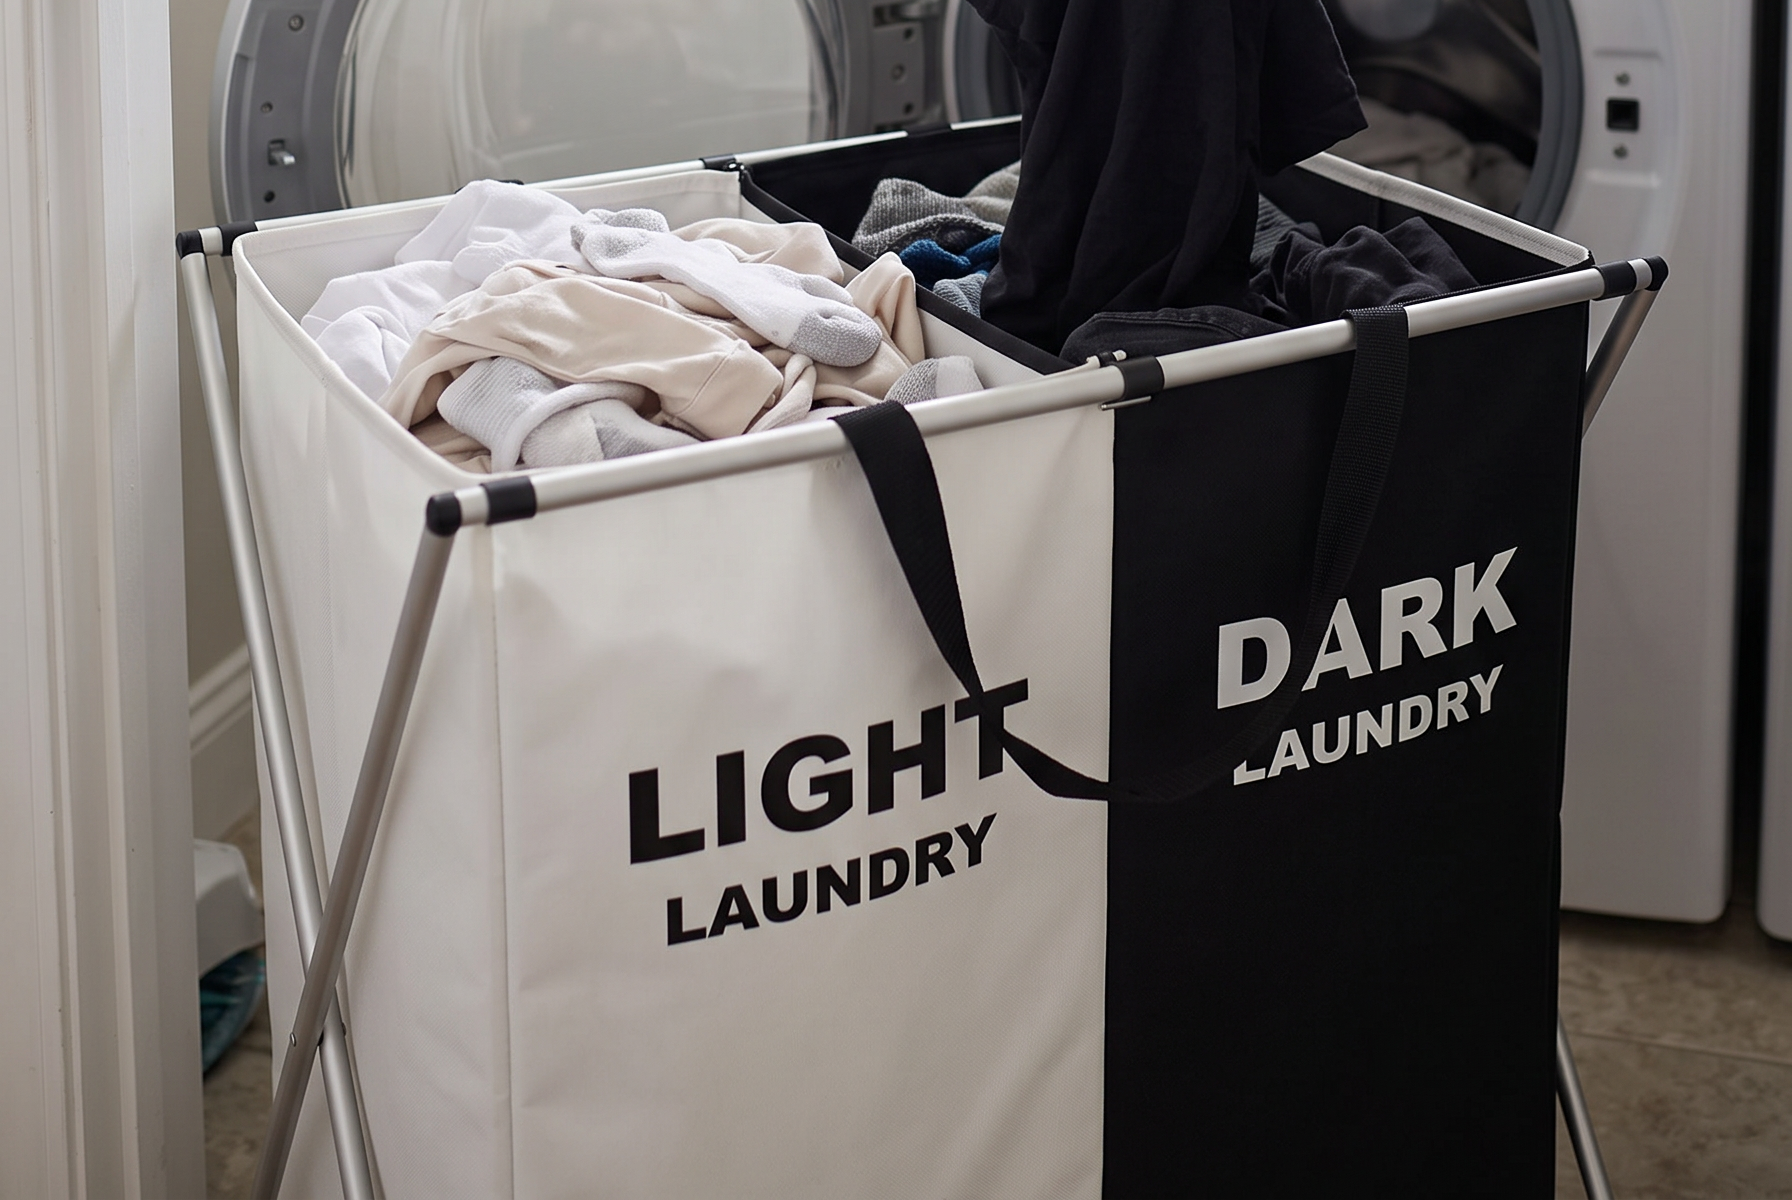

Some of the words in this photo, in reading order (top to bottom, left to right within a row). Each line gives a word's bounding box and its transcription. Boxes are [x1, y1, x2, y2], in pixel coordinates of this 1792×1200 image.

[1217, 546, 1518, 710] DARK
[628, 677, 1029, 865] LIGHT
[1233, 663, 1504, 786] LAUNDRY
[667, 812, 998, 947] LAUNDRY
